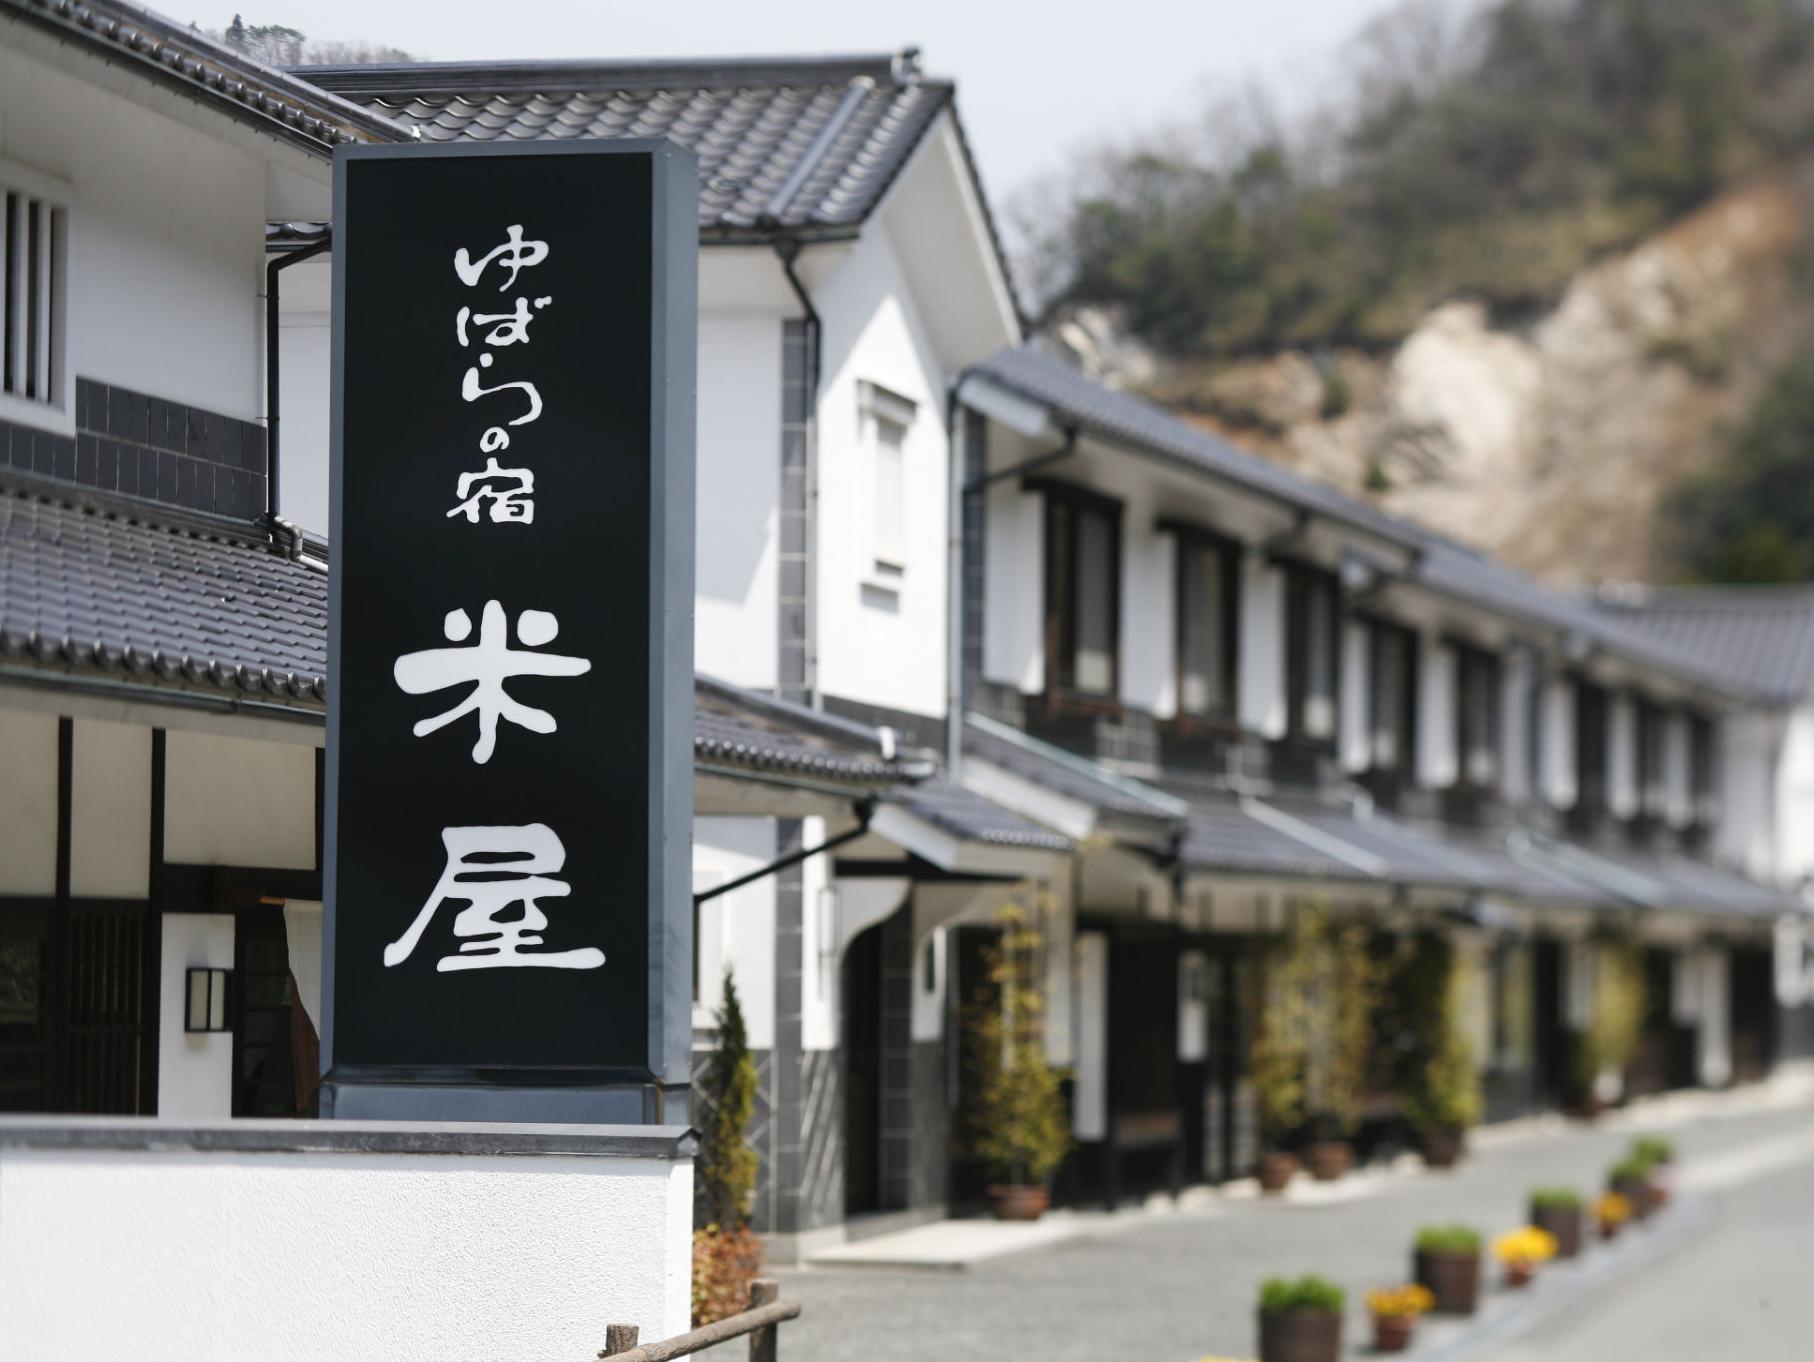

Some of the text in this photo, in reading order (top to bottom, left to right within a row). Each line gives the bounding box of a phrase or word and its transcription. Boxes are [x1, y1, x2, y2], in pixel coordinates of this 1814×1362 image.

[446, 224, 553, 525] ゆばらの宿
[383, 599, 606, 973] 米屋
